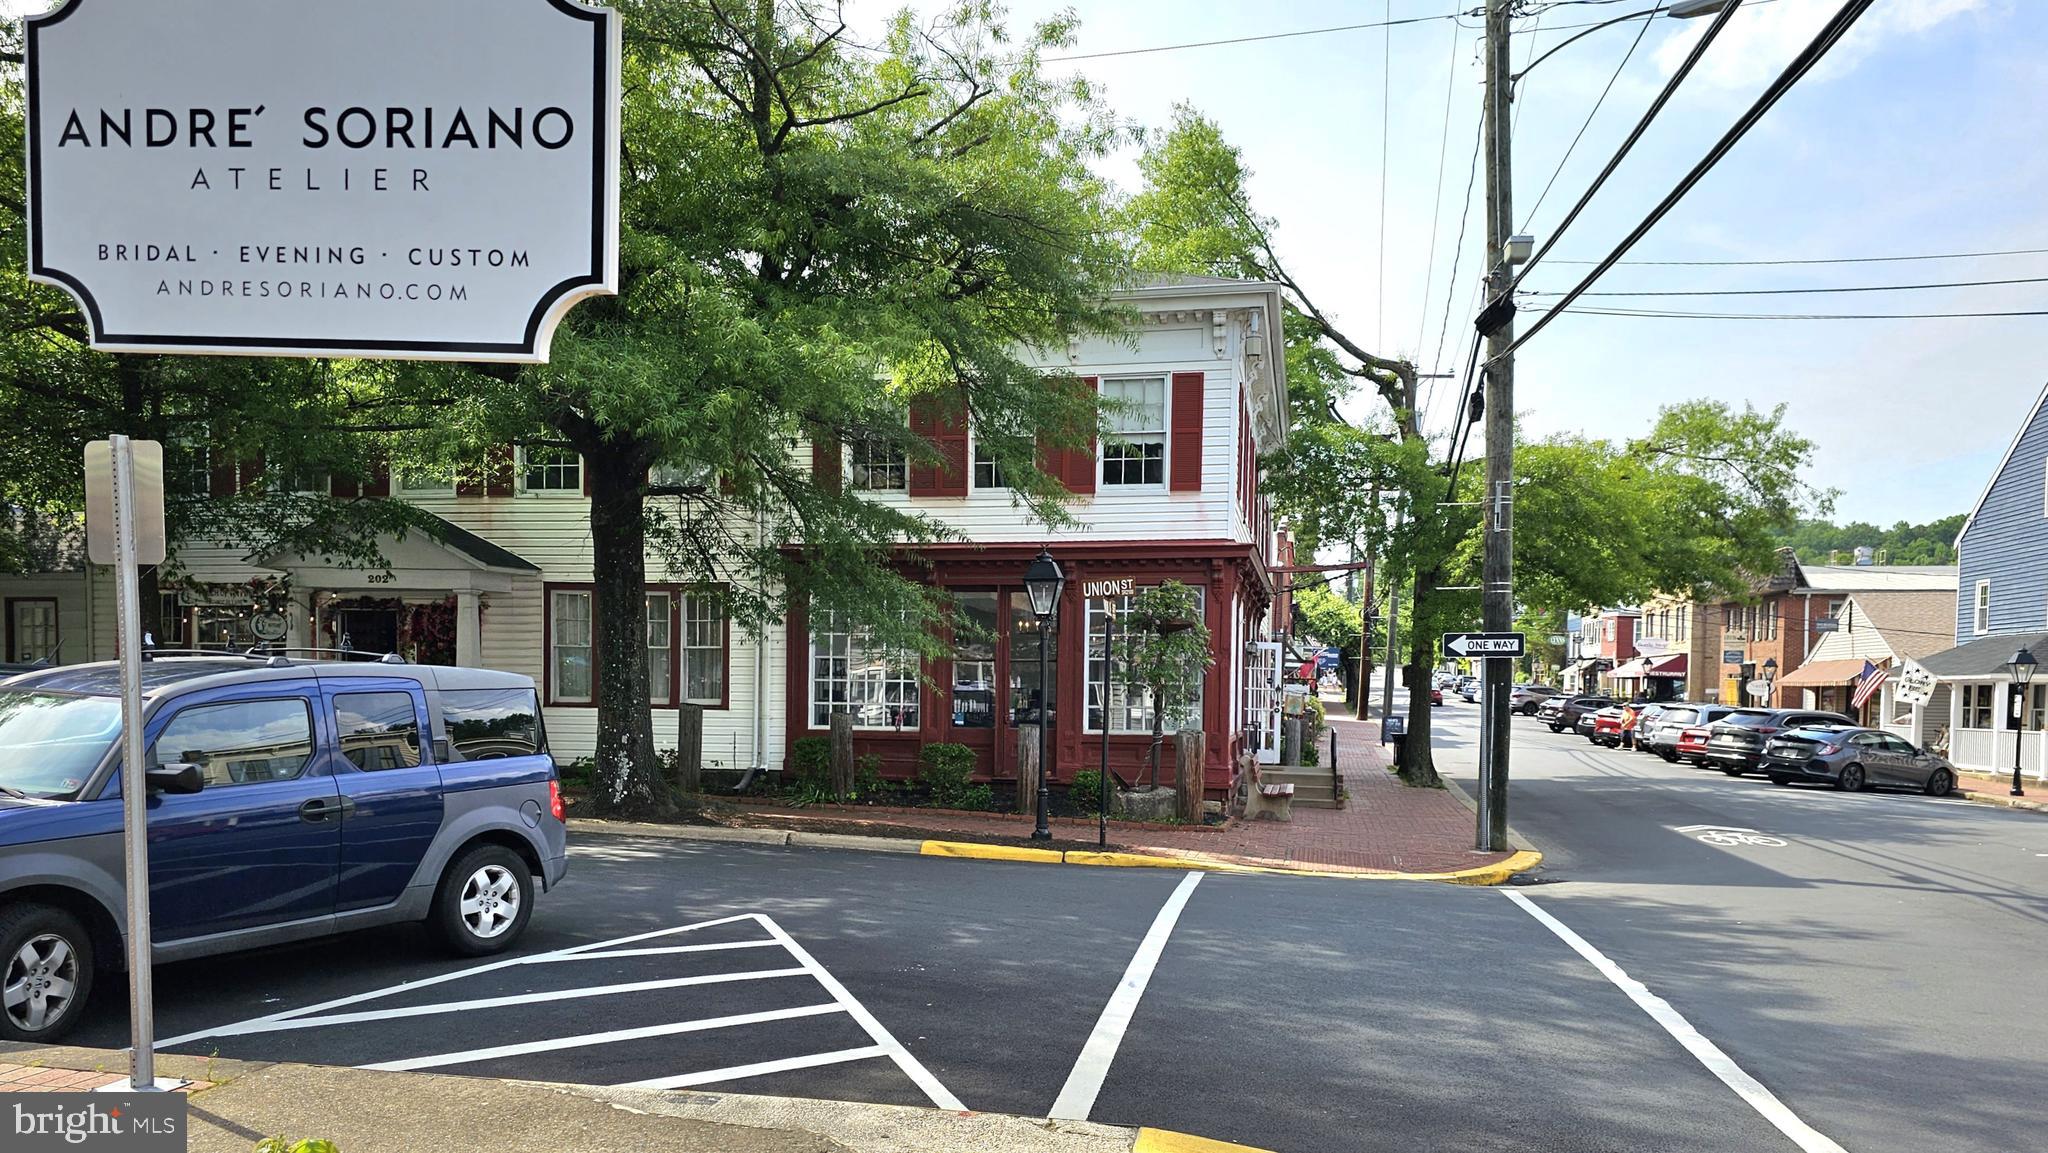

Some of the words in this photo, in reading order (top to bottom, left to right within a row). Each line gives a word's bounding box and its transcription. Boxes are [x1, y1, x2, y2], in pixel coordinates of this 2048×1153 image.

[302, 106, 574, 150] SORIANO
[190, 167, 430, 192] ATELIER
[98, 243, 197, 262] BRIDAL
[240, 245, 365, 265] EVENING
[408, 247, 529, 267] CUSTOM
[156, 279, 467, 302] ANDRESORIANO.COM
[367, 574, 389, 584] 202
[1083, 580, 1120, 597] UNION
[1120, 579, 1133, 590] ST
[1467, 640, 1489, 650] ONE
[1493, 640, 1516, 650] WAY
